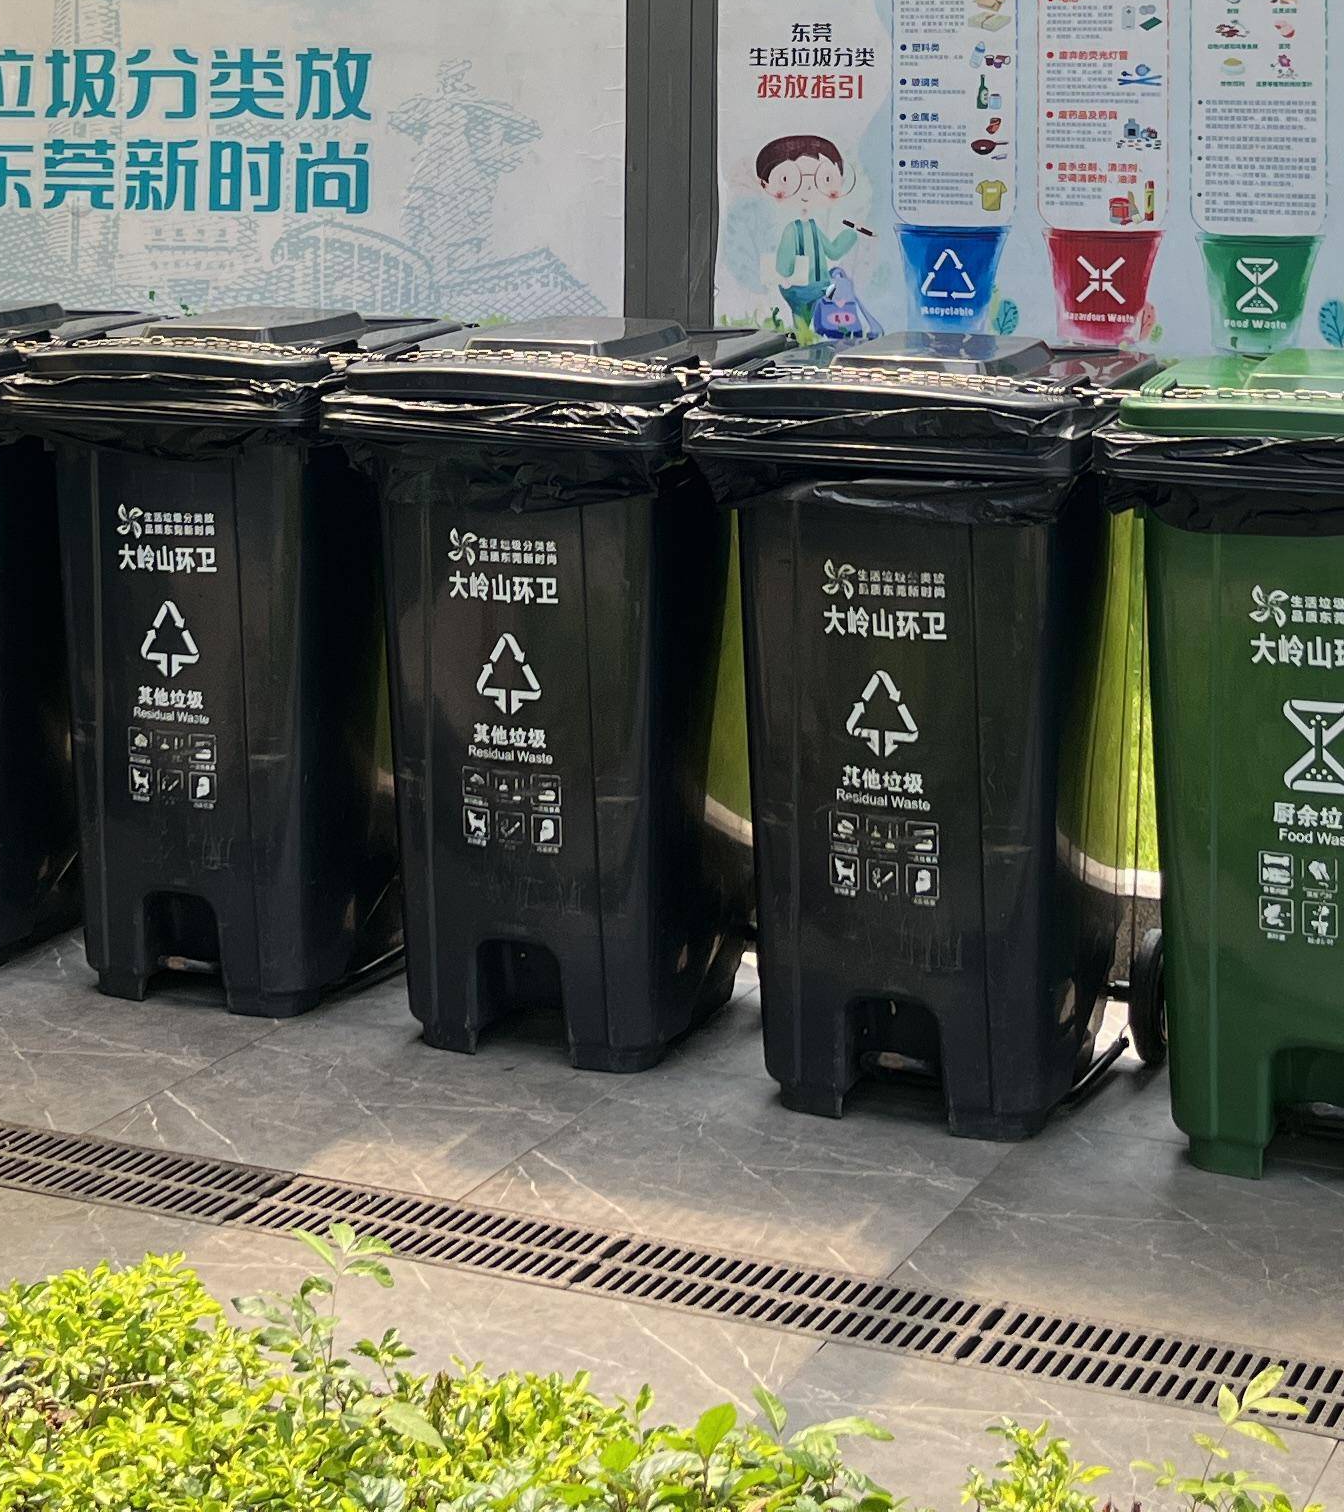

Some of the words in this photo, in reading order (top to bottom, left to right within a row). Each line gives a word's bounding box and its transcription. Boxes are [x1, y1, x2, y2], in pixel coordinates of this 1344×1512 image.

[791, 22, 833, 43] 东莞
[749, 47, 875, 68] 生活垃圾分类
[757, 74, 864, 99] 投放指引
[1251, 319, 1287, 330] Waste
[118, 543, 217, 574] 大岭山环卫
[449, 570, 559, 605] 大岭山环卫
[824, 604, 947, 640] 大岭山环卫
[137, 686, 204, 709] 其他垃圾
[133, 706, 174, 724] Residual
[176, 710, 210, 725] Waste
[473, 723, 547, 749] 其他垃圾
[468, 744, 514, 763] Residual
[517, 749, 553, 765] Waste
[842, 764, 924, 794] 其他垃圾
[836, 788, 888, 807] Residual
[891, 793, 930, 812] Waste
[1278, 827, 1313, 844] Food
